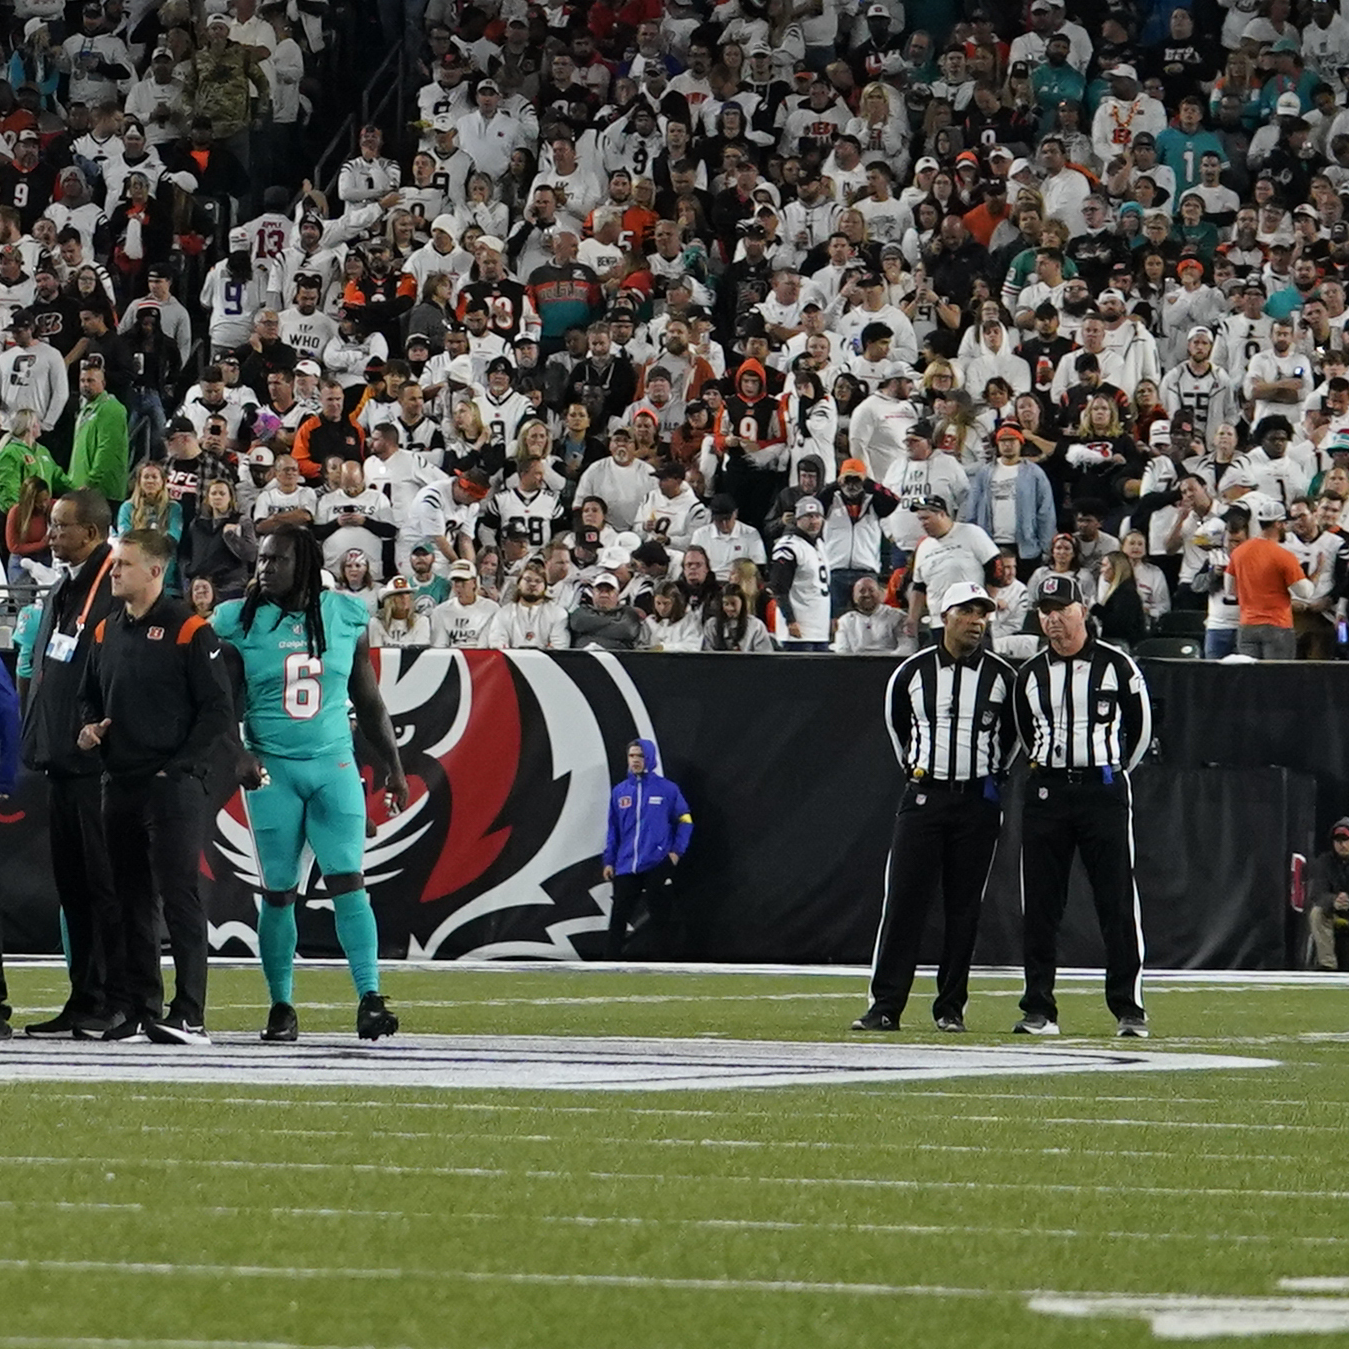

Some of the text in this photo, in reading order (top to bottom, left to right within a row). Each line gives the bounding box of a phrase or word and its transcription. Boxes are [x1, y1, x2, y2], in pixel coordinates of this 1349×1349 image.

[633, 149, 648, 175] 9
[1183, 151, 1193, 182] 1
[13, 183, 30, 207] 9
[256, 229, 284, 258] 13
[225, 281, 244, 315] 9
[289, 333, 320, 348] WHO
[739, 417, 758, 442] 9
[902, 483, 931, 495] WHO
[819, 565, 830, 597] 9
[449, 629, 475, 643] WHO
[282, 651, 322, 720] 6
